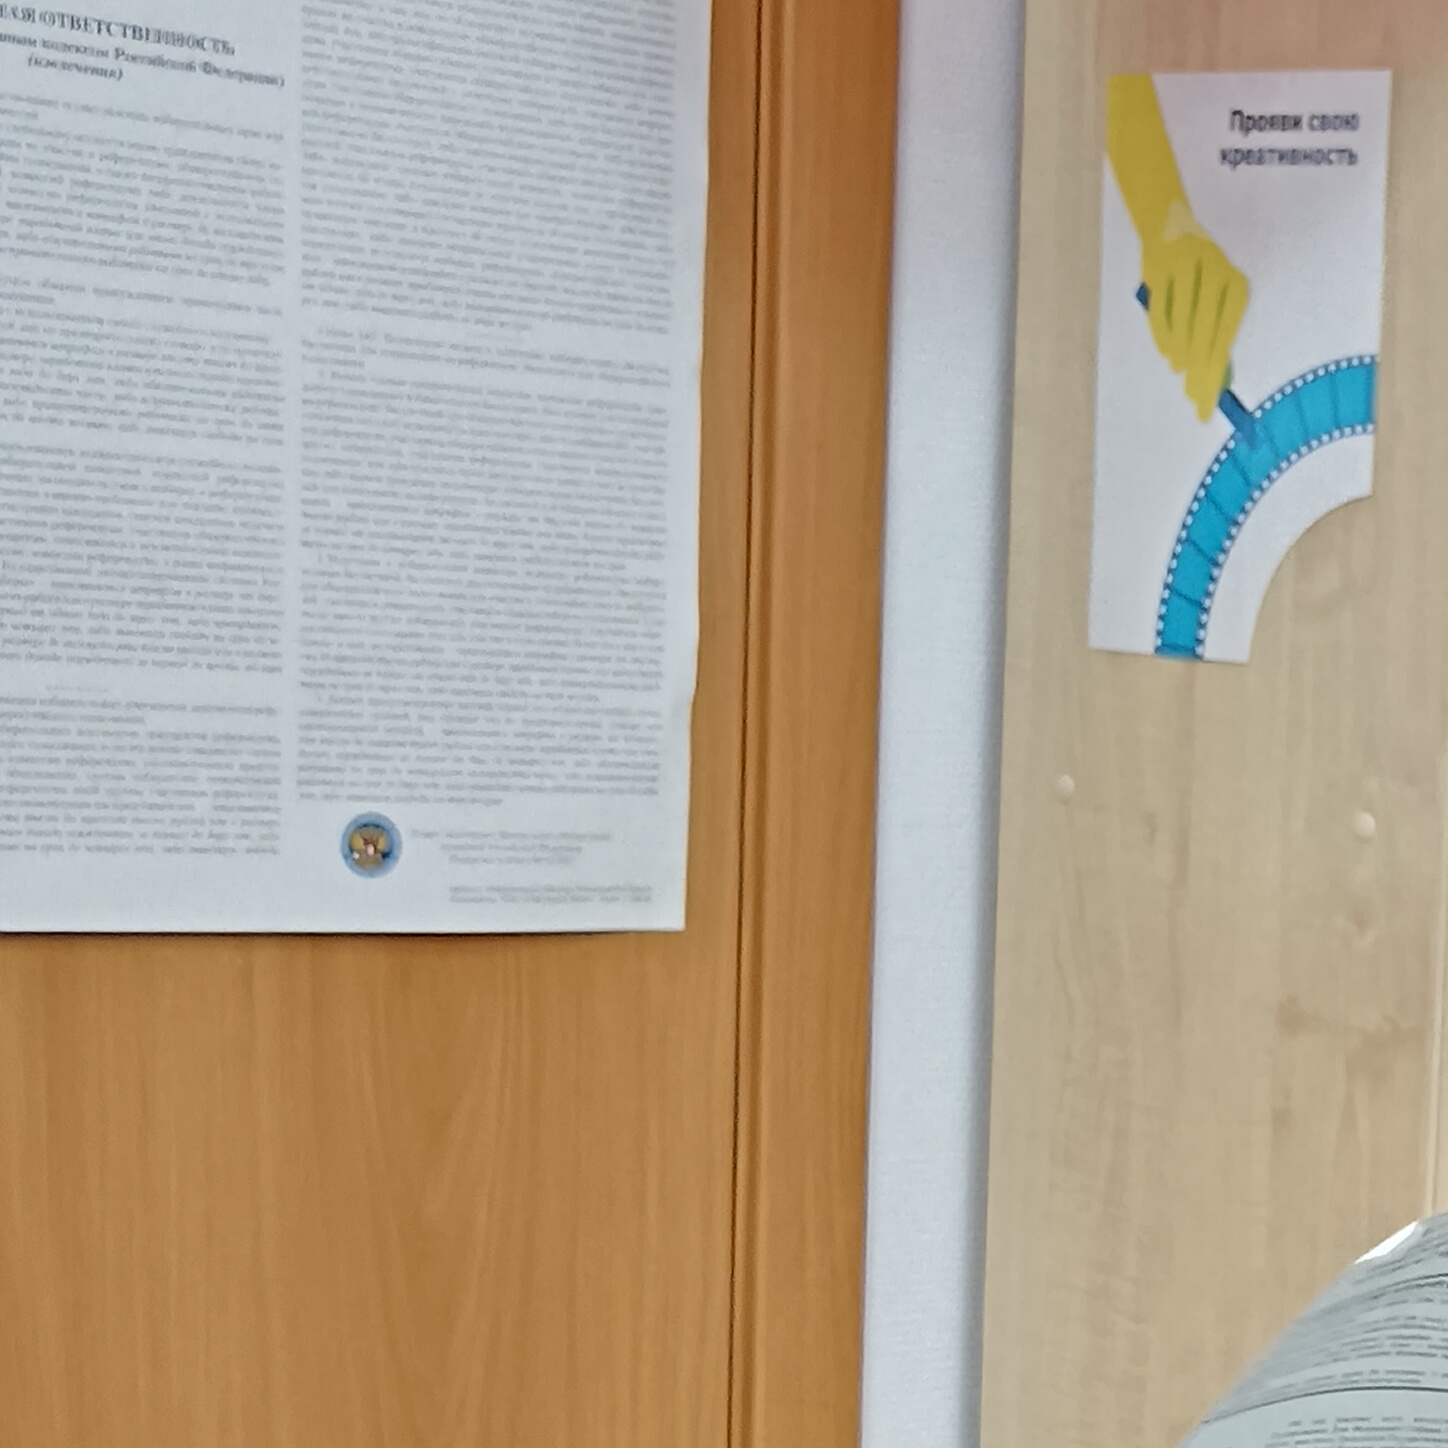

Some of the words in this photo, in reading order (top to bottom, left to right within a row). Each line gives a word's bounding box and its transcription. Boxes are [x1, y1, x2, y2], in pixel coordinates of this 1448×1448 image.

[1229, 109, 1303, 137] Прояви
[1307, 114, 1360, 132] свою
[1220, 147, 1358, 171] креативность
